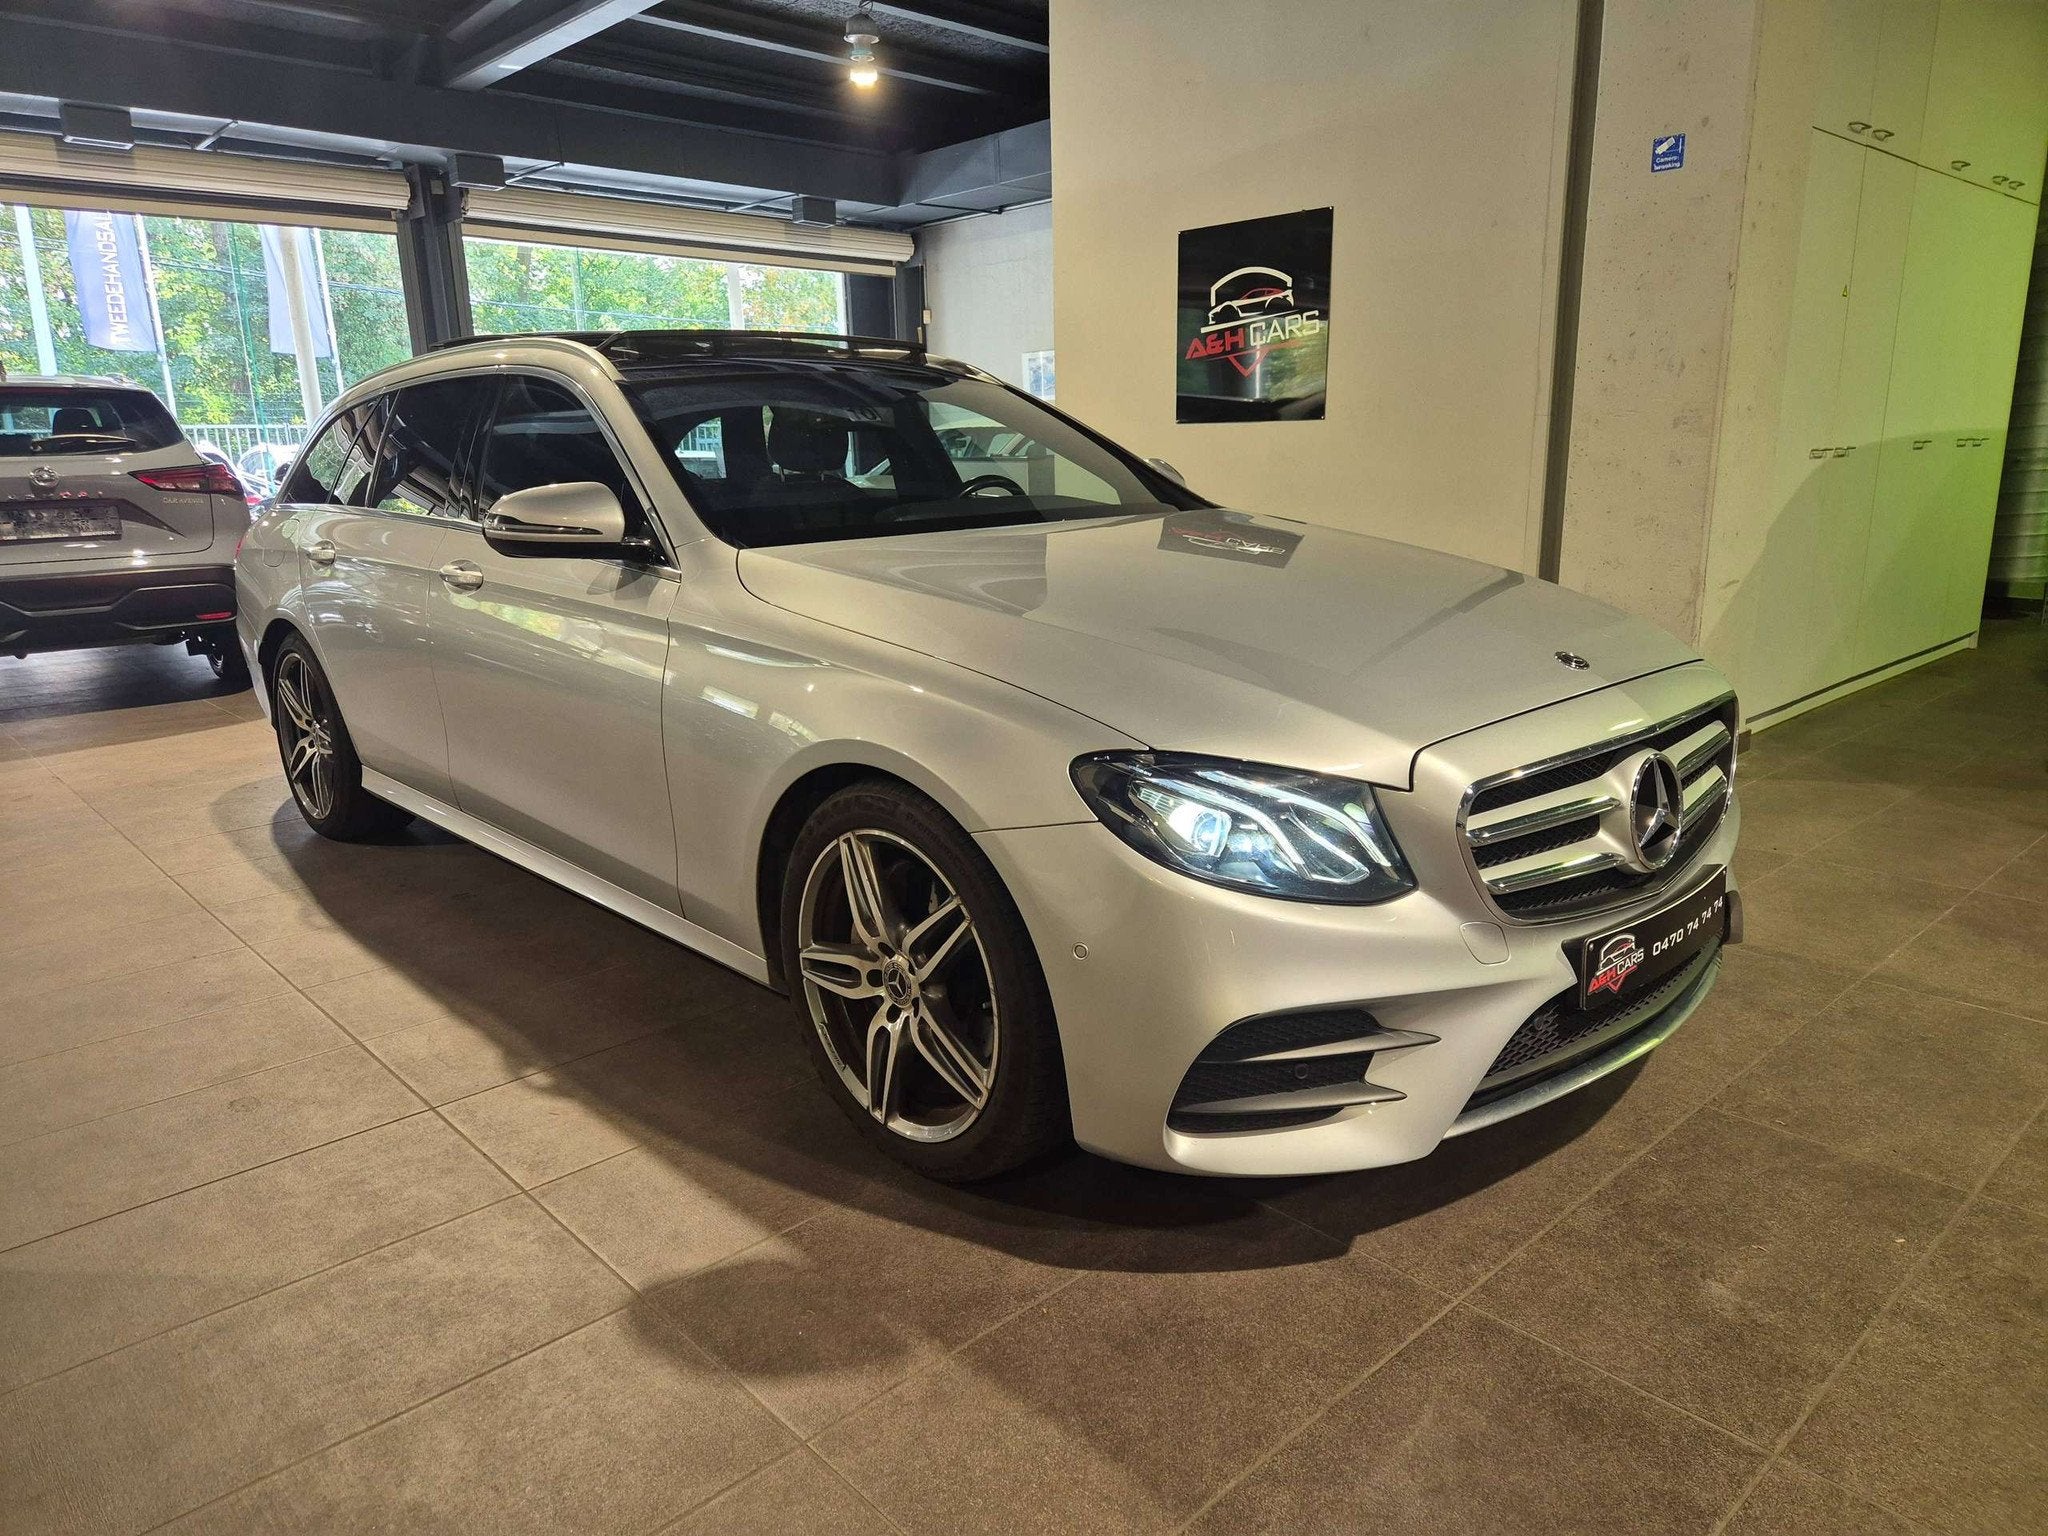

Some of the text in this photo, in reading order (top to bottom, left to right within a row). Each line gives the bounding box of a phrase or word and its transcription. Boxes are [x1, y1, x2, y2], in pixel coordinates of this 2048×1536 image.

[1185, 310, 1320, 359] A&H CARS
[1652, 896, 1723, 956] 0470 74 74 74
[1617, 948, 1644, 975] CARS
